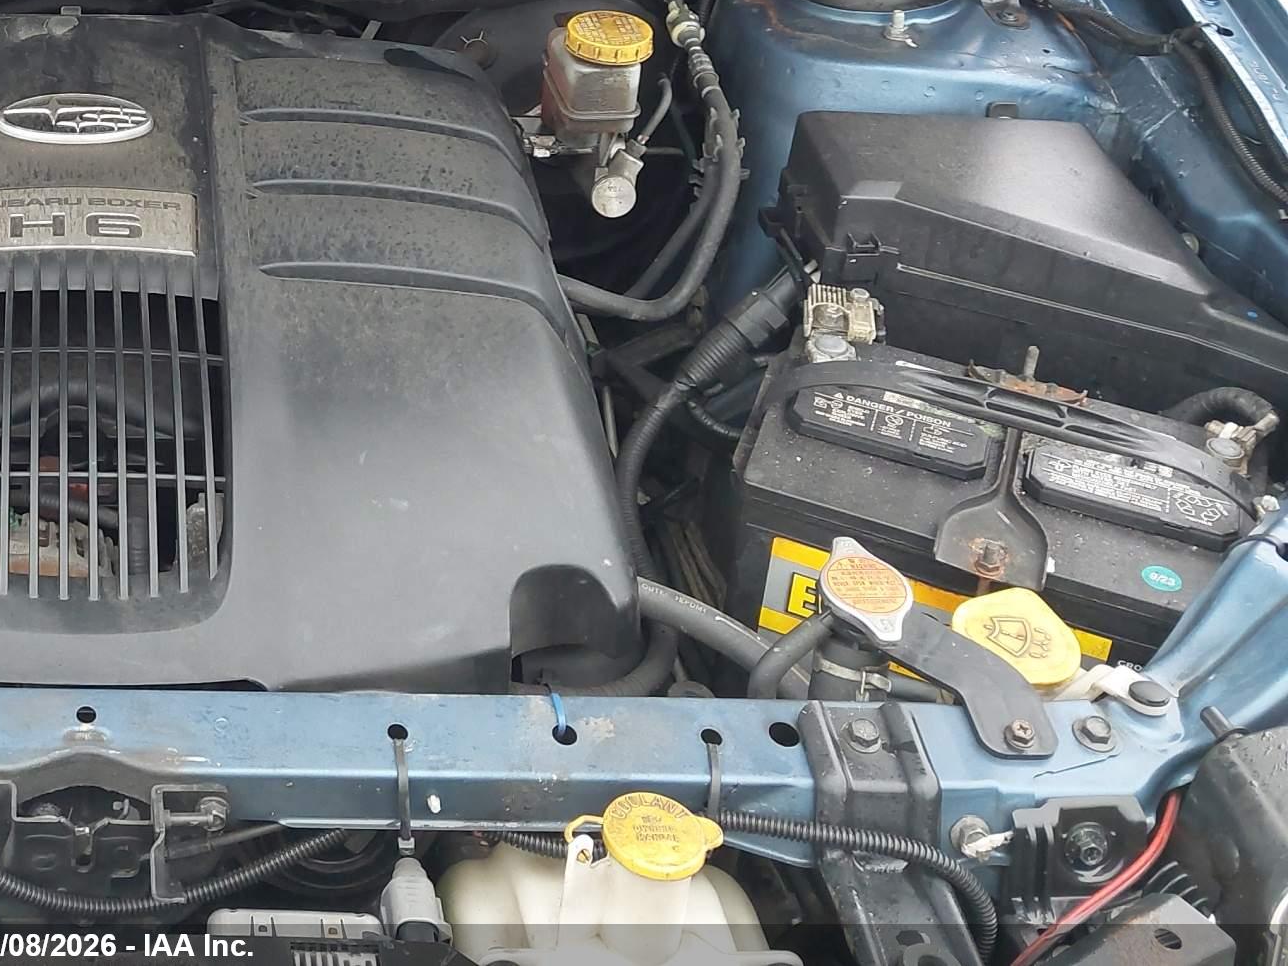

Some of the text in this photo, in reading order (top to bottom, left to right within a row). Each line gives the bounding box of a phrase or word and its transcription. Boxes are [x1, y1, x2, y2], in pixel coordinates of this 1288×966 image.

[88, 197, 181, 210] BOXER
[846, 395, 894, 413] DANGER
[906, 411, 952, 427] POISON
[610, 794, 689, 819] COOLANT
